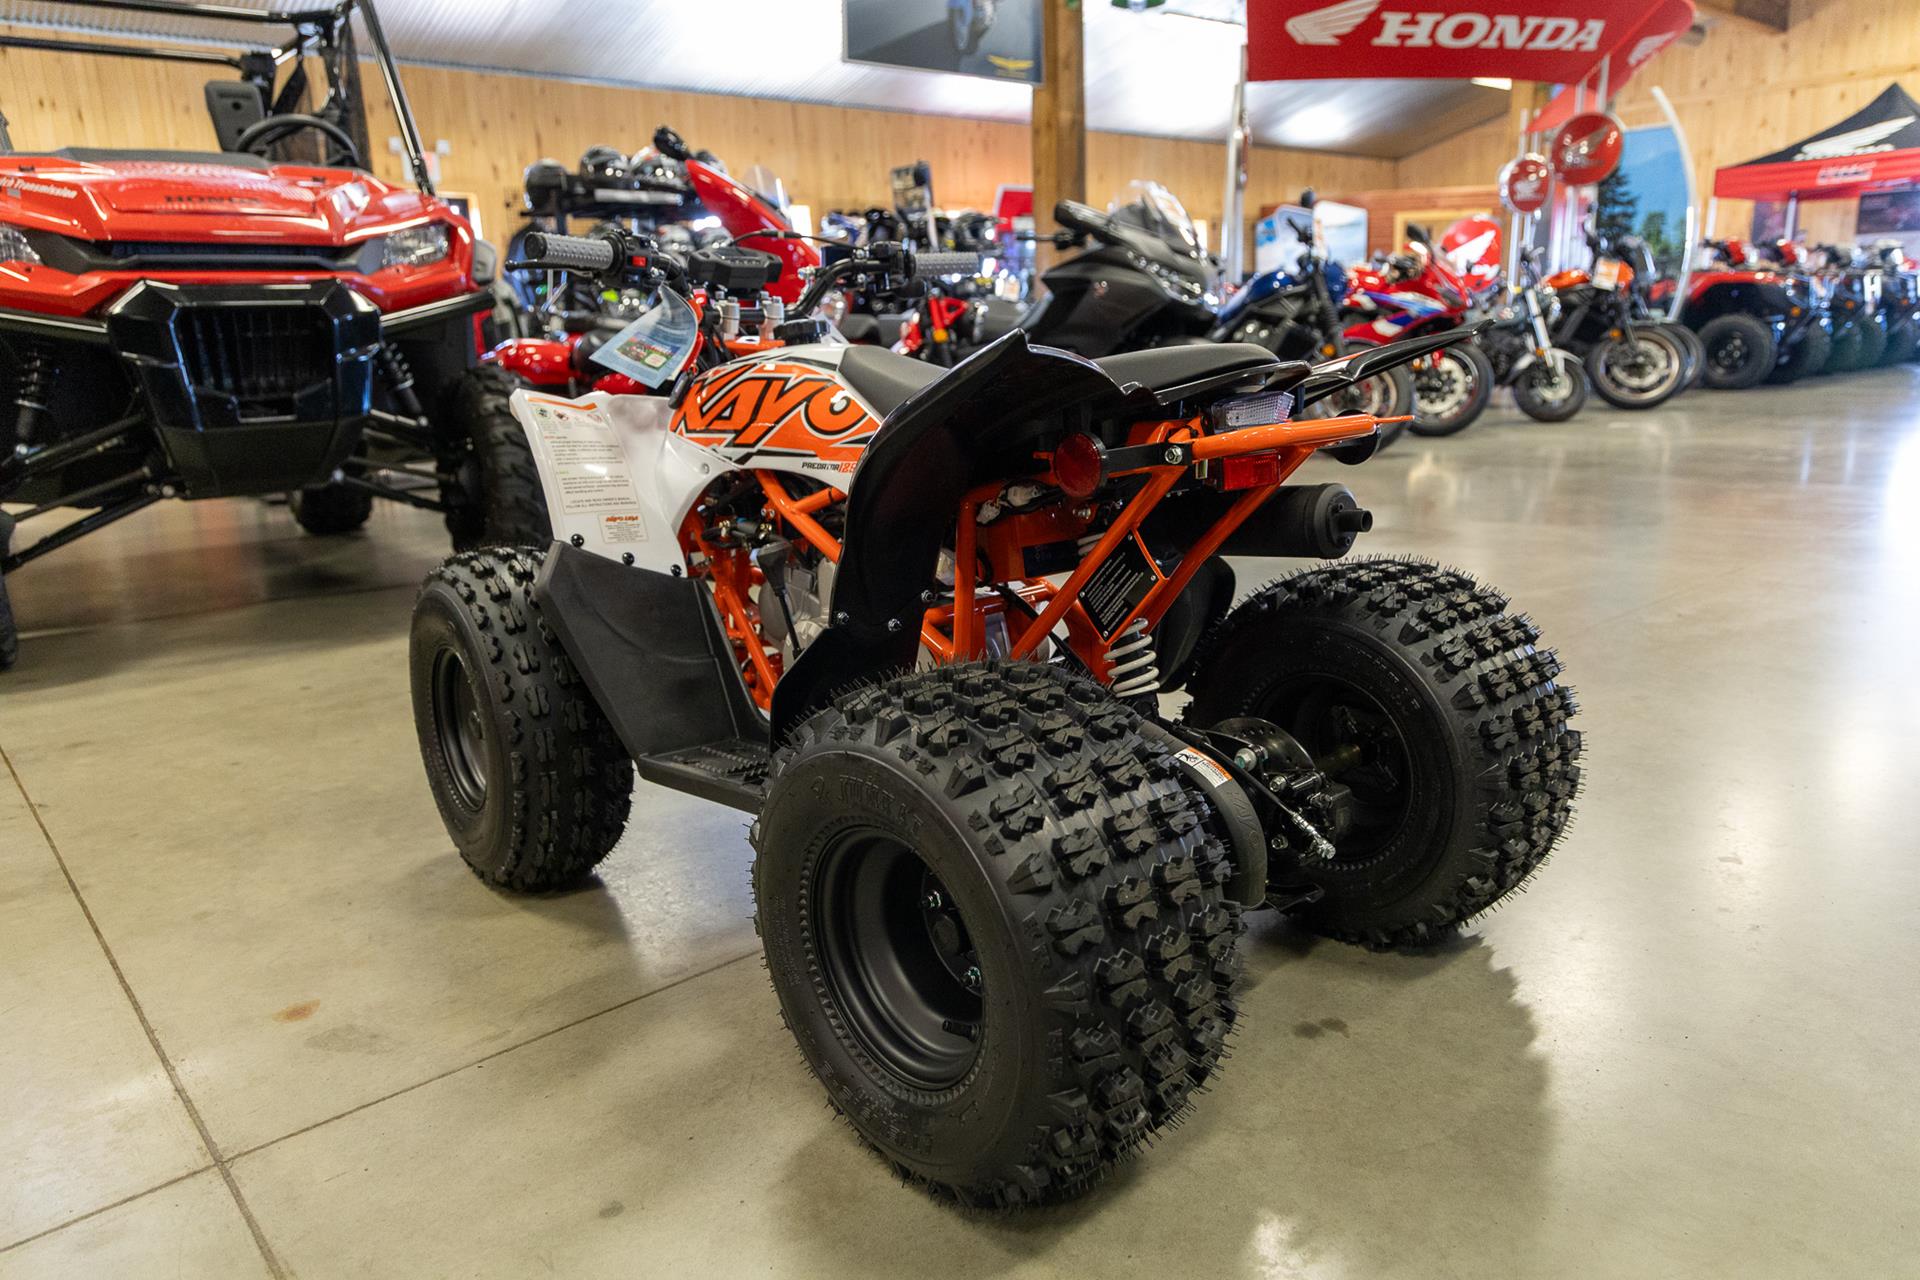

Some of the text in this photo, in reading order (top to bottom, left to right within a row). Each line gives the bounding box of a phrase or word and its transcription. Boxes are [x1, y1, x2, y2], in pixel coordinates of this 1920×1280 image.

[1371, 11, 1606, 51] HONDA
[14, 178, 78, 199] Transmission
[668, 363, 868, 448] KAYO
